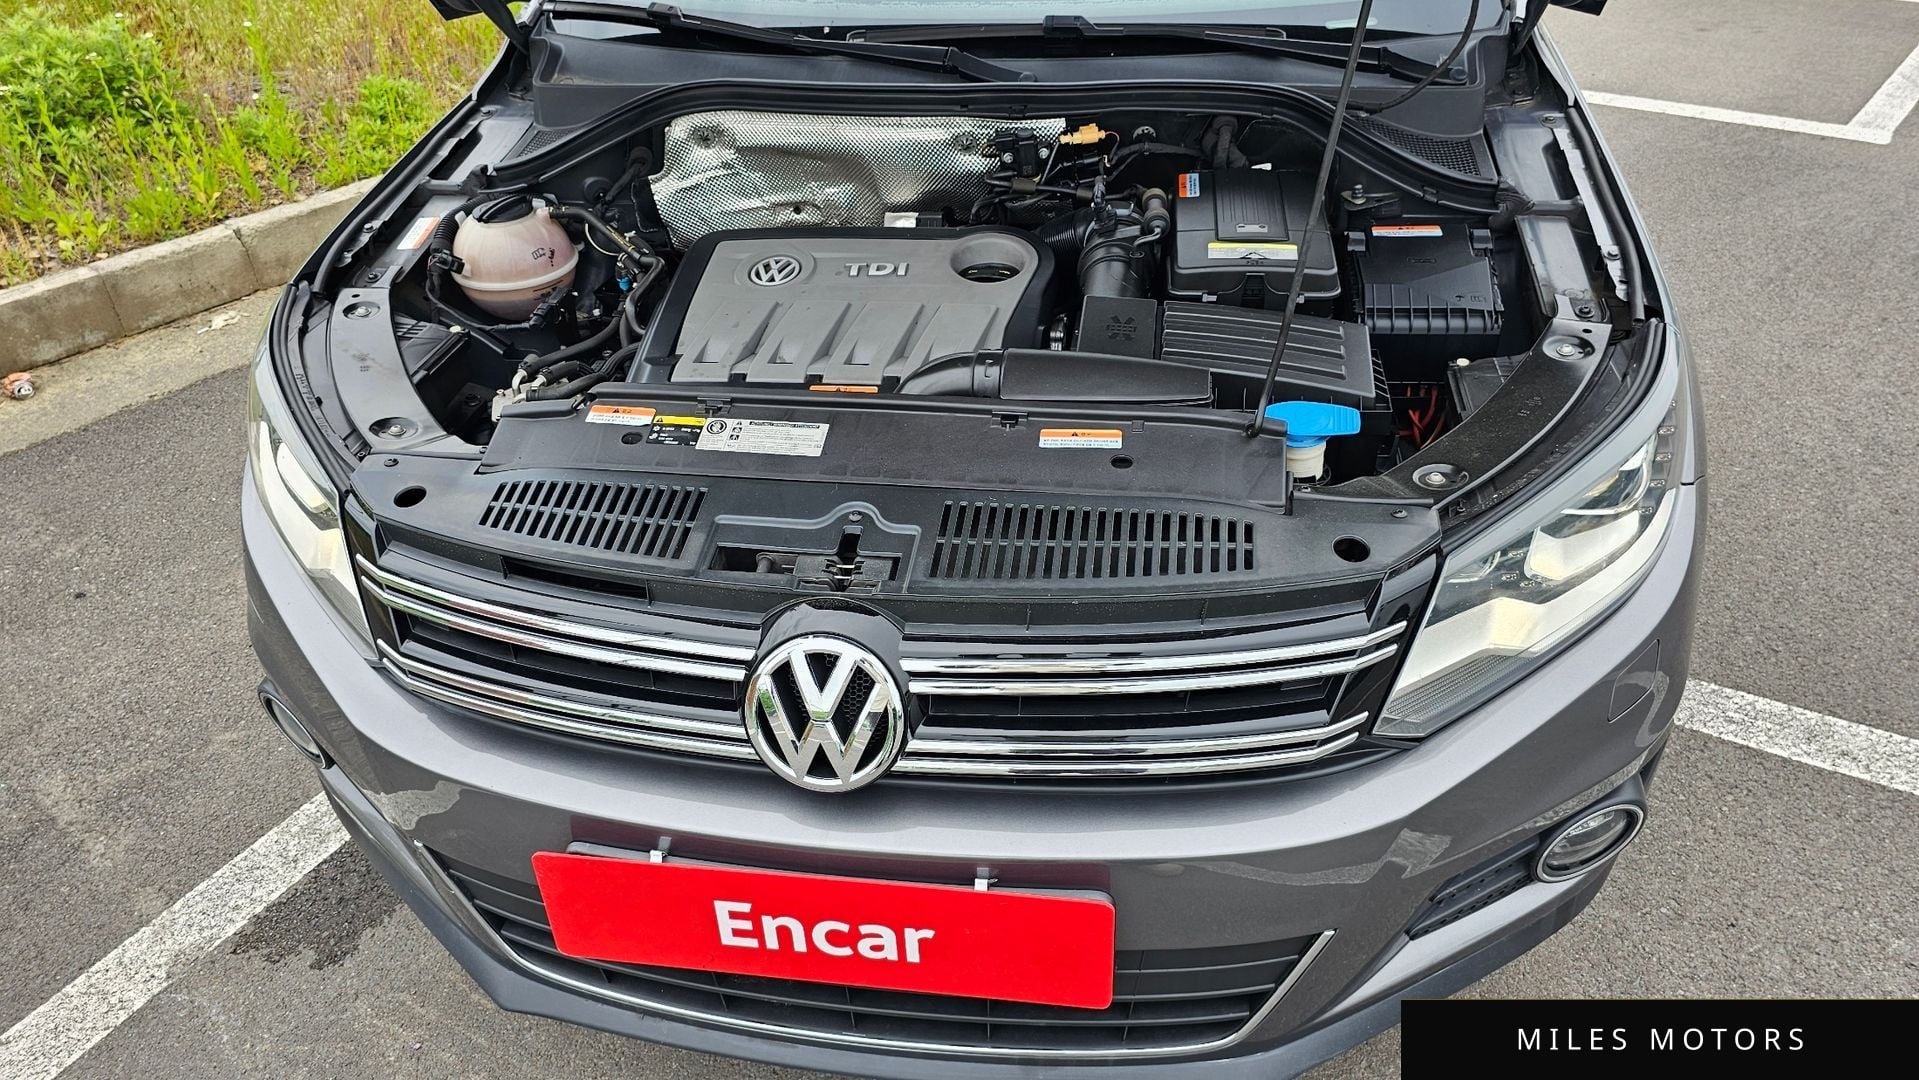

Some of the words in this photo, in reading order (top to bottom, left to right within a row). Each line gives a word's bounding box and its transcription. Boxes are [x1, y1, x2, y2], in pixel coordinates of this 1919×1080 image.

[844, 262, 909, 277] TDI
[745, 635, 905, 792] VW
[712, 899, 936, 964] Encar
